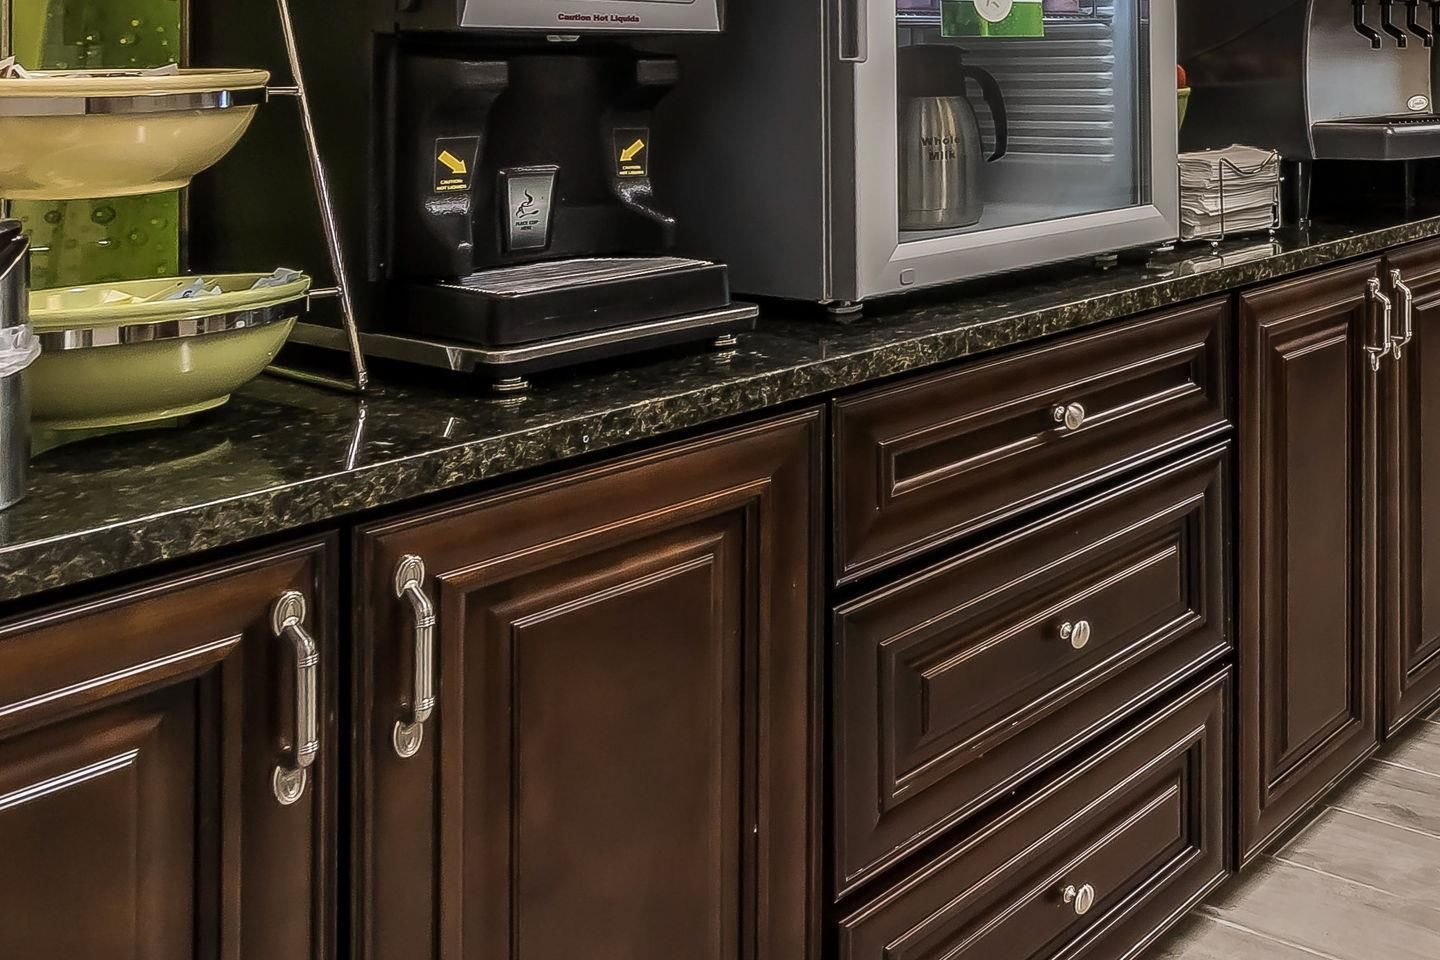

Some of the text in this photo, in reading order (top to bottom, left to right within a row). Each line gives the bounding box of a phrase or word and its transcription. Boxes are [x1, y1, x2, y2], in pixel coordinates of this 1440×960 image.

[558, 13, 640, 23] Caution Hot Liquids
[921, 135, 960, 146] Whole
